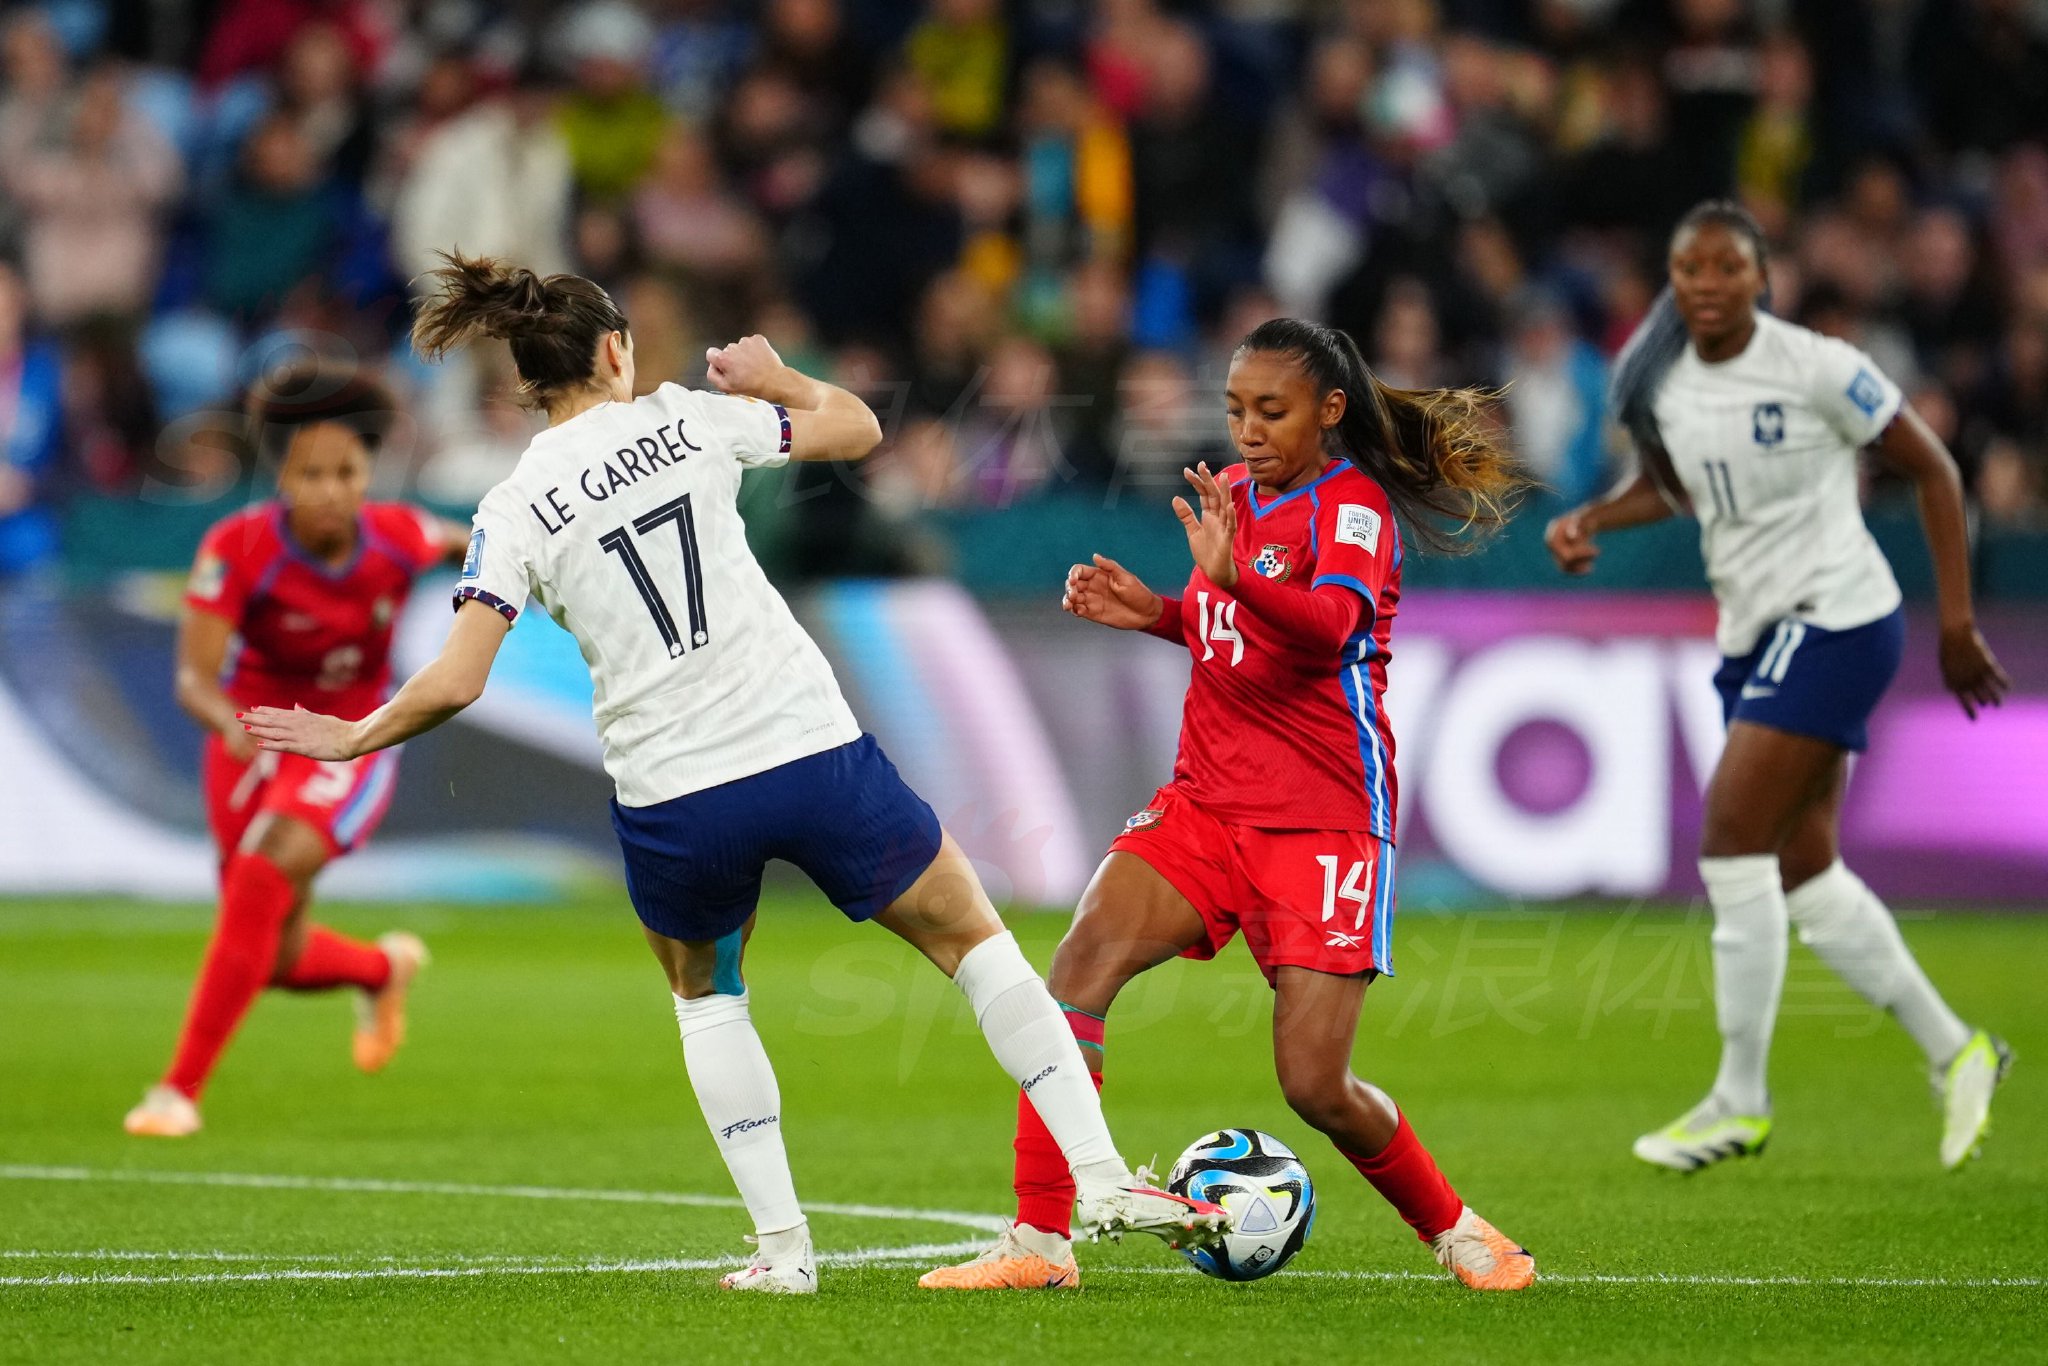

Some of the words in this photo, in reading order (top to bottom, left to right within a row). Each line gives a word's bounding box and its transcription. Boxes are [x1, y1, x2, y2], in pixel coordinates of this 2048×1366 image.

[530, 487, 576, 536] LE
[580, 418, 702, 502] GARREC
[1702, 458, 1739, 519] 11
[597, 492, 709, 660] 17
[1197, 591, 1245, 668] 14
[1757, 620, 1807, 684] 11
[1315, 854, 1374, 931] 14
[720, 1114, 778, 1140] France
